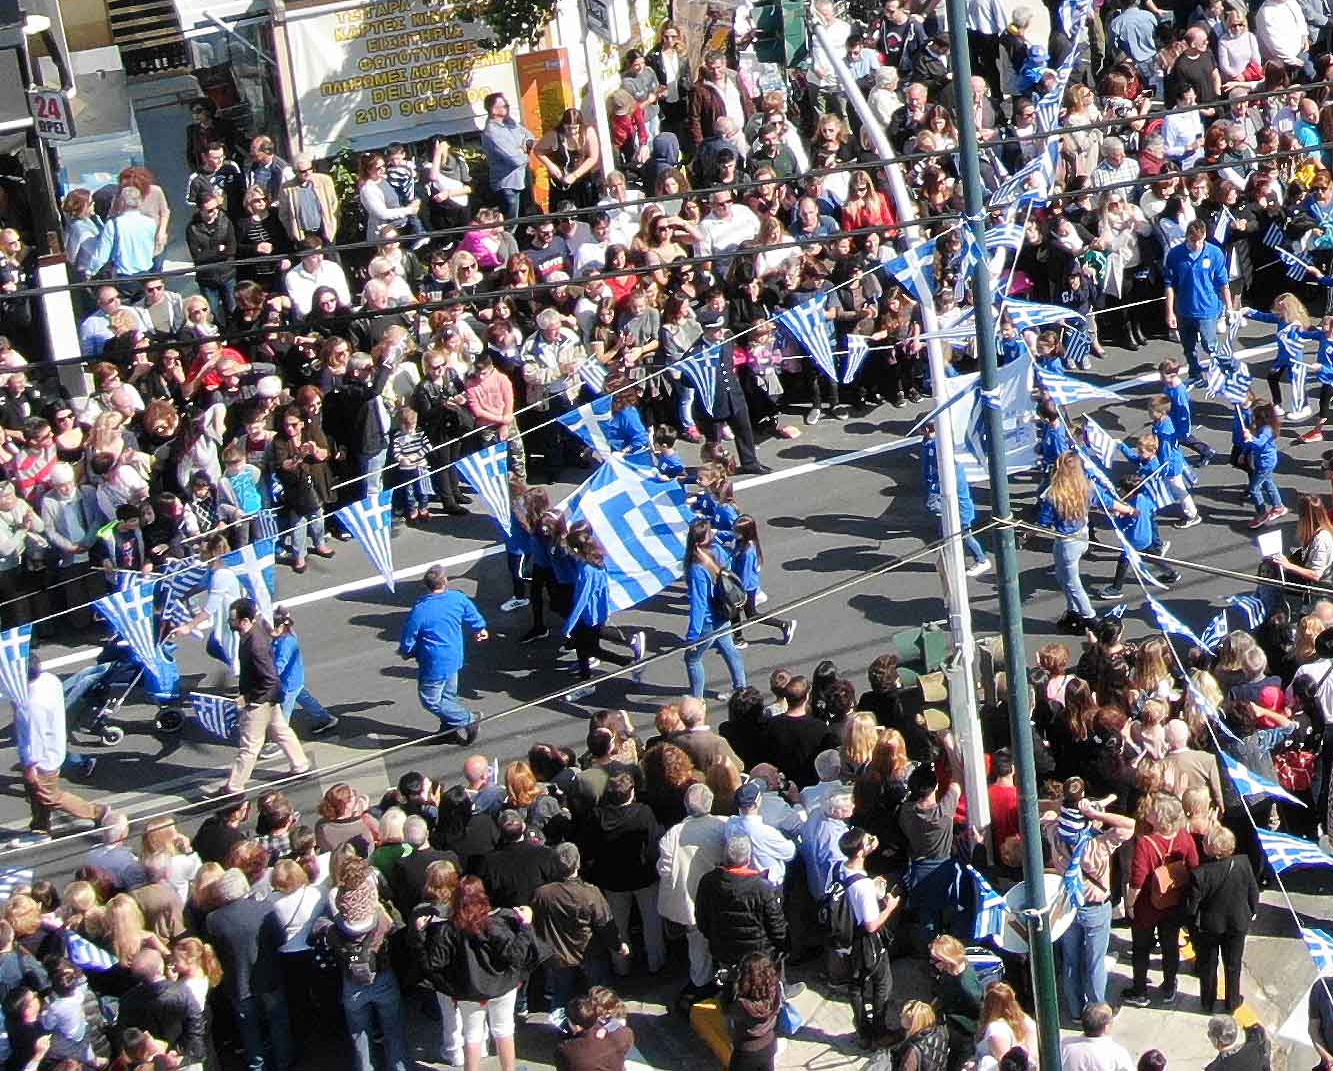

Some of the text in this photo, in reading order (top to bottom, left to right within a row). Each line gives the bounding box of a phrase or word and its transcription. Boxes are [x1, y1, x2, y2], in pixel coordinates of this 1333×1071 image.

[335, 17, 405, 42] ΚΑΡΤΕΣ
[366, 24, 464, 53] ΕΙΣΗΤΗΡΙΑ
[359, 40, 479, 72] ΦΩΤΟΤΥΠΙΕΣ
[320, 72, 406, 97] ΠΛΗΡΩΜΕΣ
[372, 72, 474, 105] DELIVERY
[34, 96, 62, 119] 24
[355, 104, 392, 125] 210
